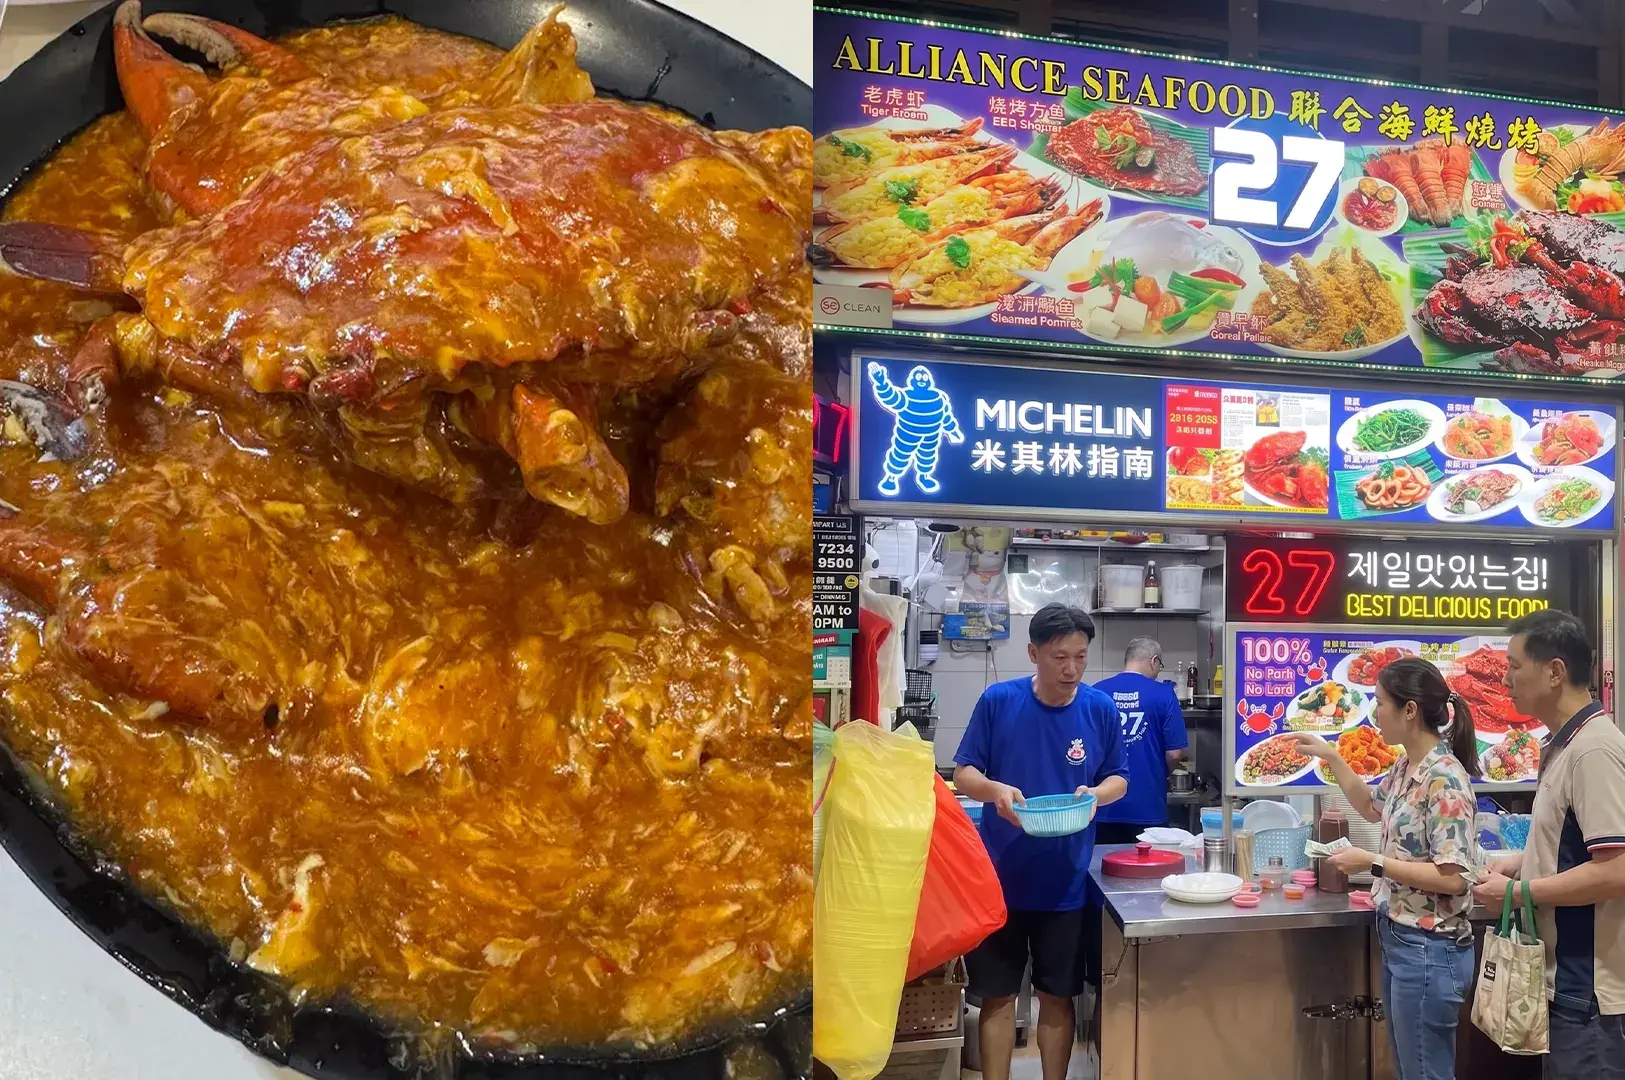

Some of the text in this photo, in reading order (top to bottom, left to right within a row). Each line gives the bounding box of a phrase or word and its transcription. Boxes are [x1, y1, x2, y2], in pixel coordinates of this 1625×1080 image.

[833, 34, 1275, 121] ALLIANCE SEAFOOD
[864, 85, 926, 108] 老虎虾
[989, 96, 1066, 121] 烧烤方鱼
[860, 104, 890, 117] Tiger
[1288, 90, 1543, 155] 聯合海鮮燒烤
[1209, 127, 1346, 230] 27
[844, 304, 880, 315] CLEAN
[975, 398, 1153, 439] MICHELIN
[971, 439, 1154, 480] 米其林指南
[818, 543, 854, 554] 7234
[818, 557, 854, 568] 9500
[1347, 551, 1548, 591] 제일맛있는집!
[1243, 549, 1336, 615] 27
[813, 604, 852, 616] AM to
[1345, 594, 1395, 617] BEST
[1399, 595, 1490, 619] DELICIOUS
[1243, 638, 1312, 664] 100%
[1245, 667, 1264, 680] No
[1245, 683, 1295, 696] No Lard
[1119, 712, 1144, 735] 27
